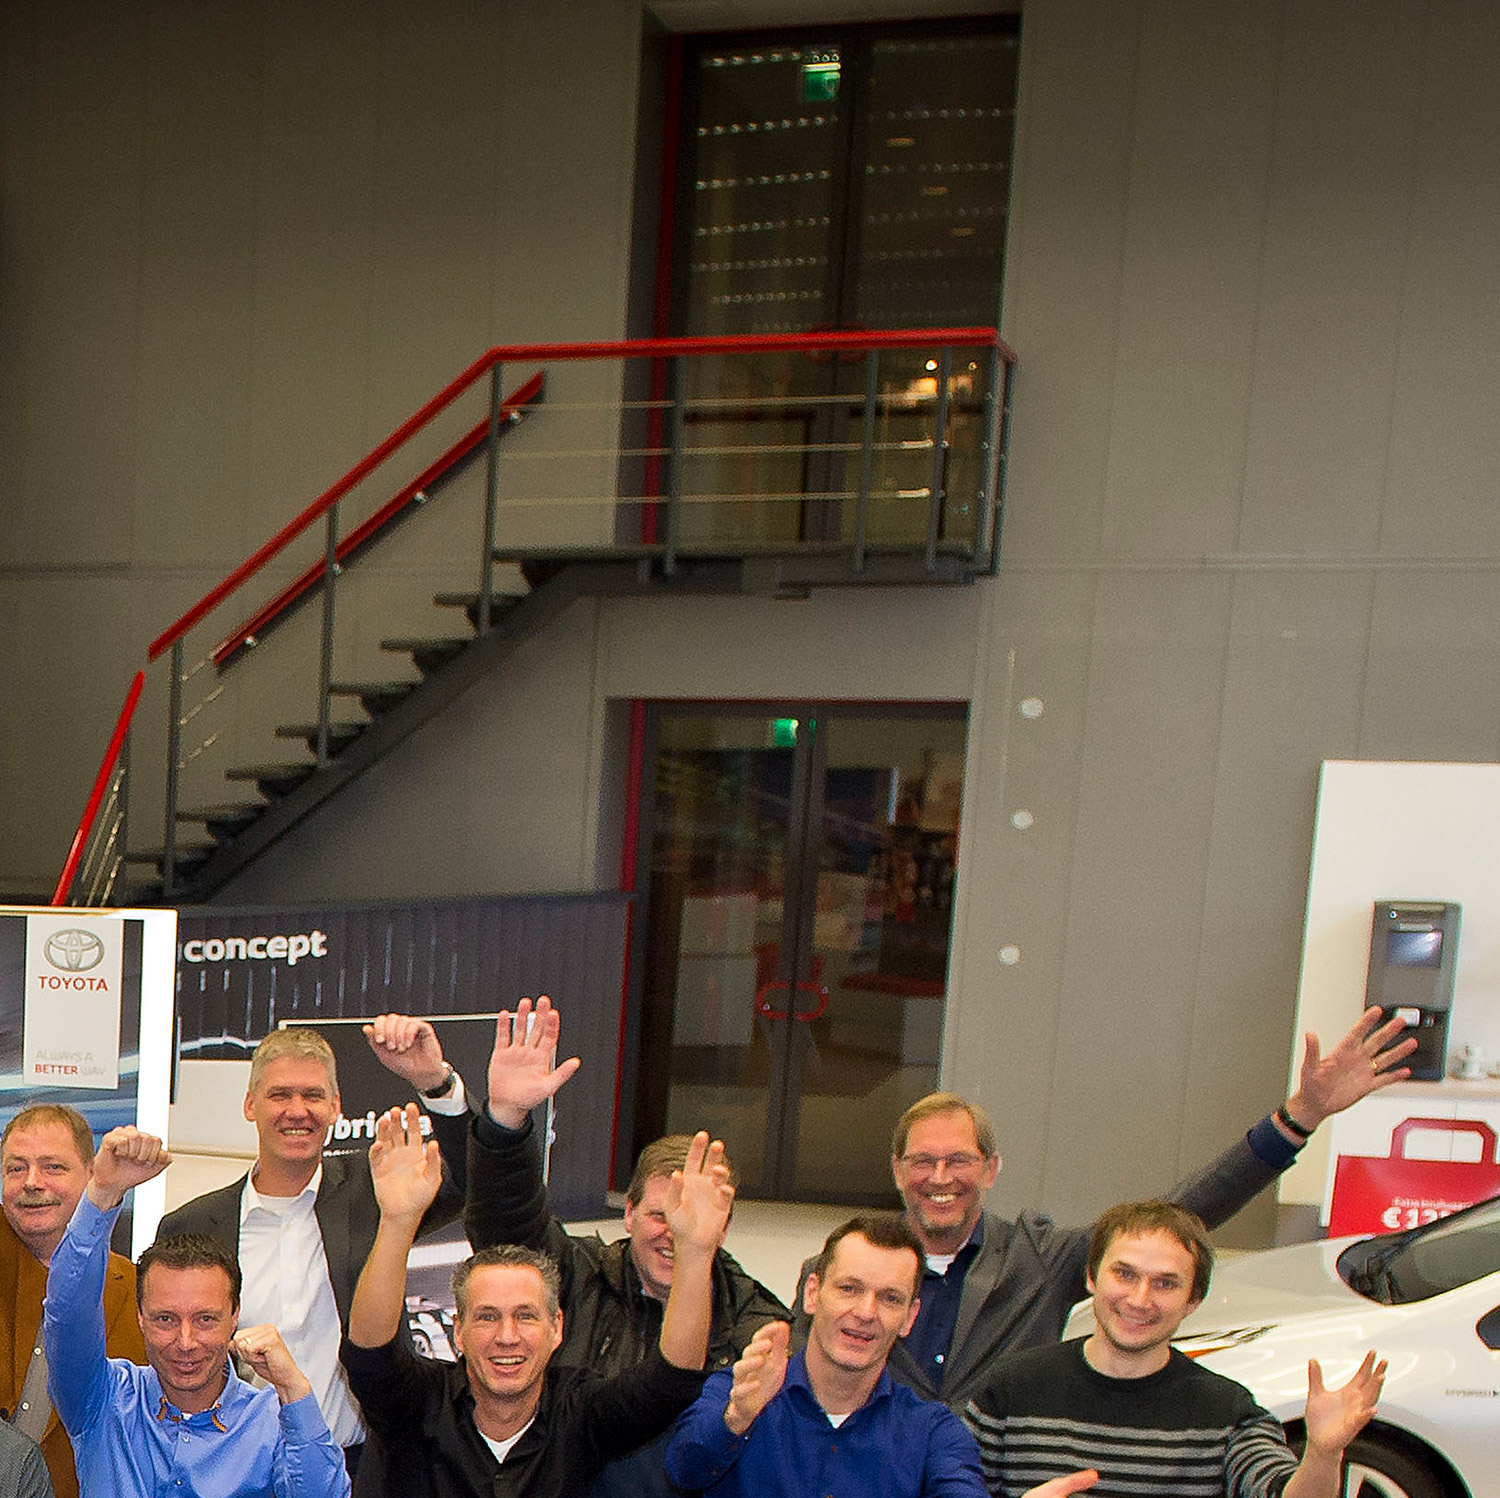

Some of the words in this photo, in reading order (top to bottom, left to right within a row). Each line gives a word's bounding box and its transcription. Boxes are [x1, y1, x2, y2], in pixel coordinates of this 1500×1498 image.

[183, 928, 329, 967] concept
[38, 975, 109, 992] TOYOTA
[35, 1050, 83, 1061] ALWAYS
[34, 1063, 78, 1075] BETTER
